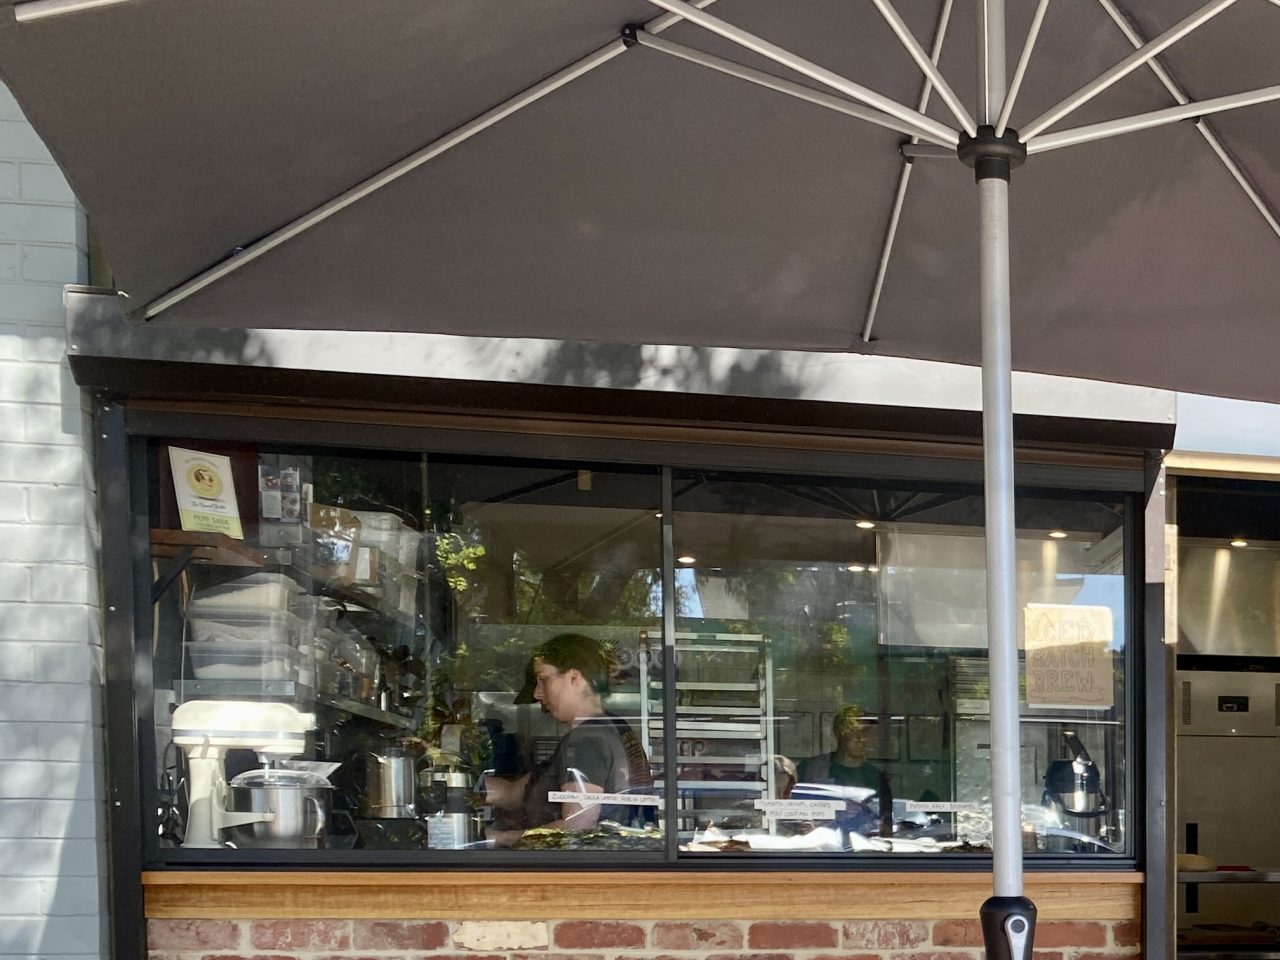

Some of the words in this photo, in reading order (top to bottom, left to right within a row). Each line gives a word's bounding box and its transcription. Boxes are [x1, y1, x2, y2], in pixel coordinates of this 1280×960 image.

[1031, 619, 1095, 642] ICED
[1032, 645, 1095, 668] BATCH
[1032, 669, 1095, 693] BREW
